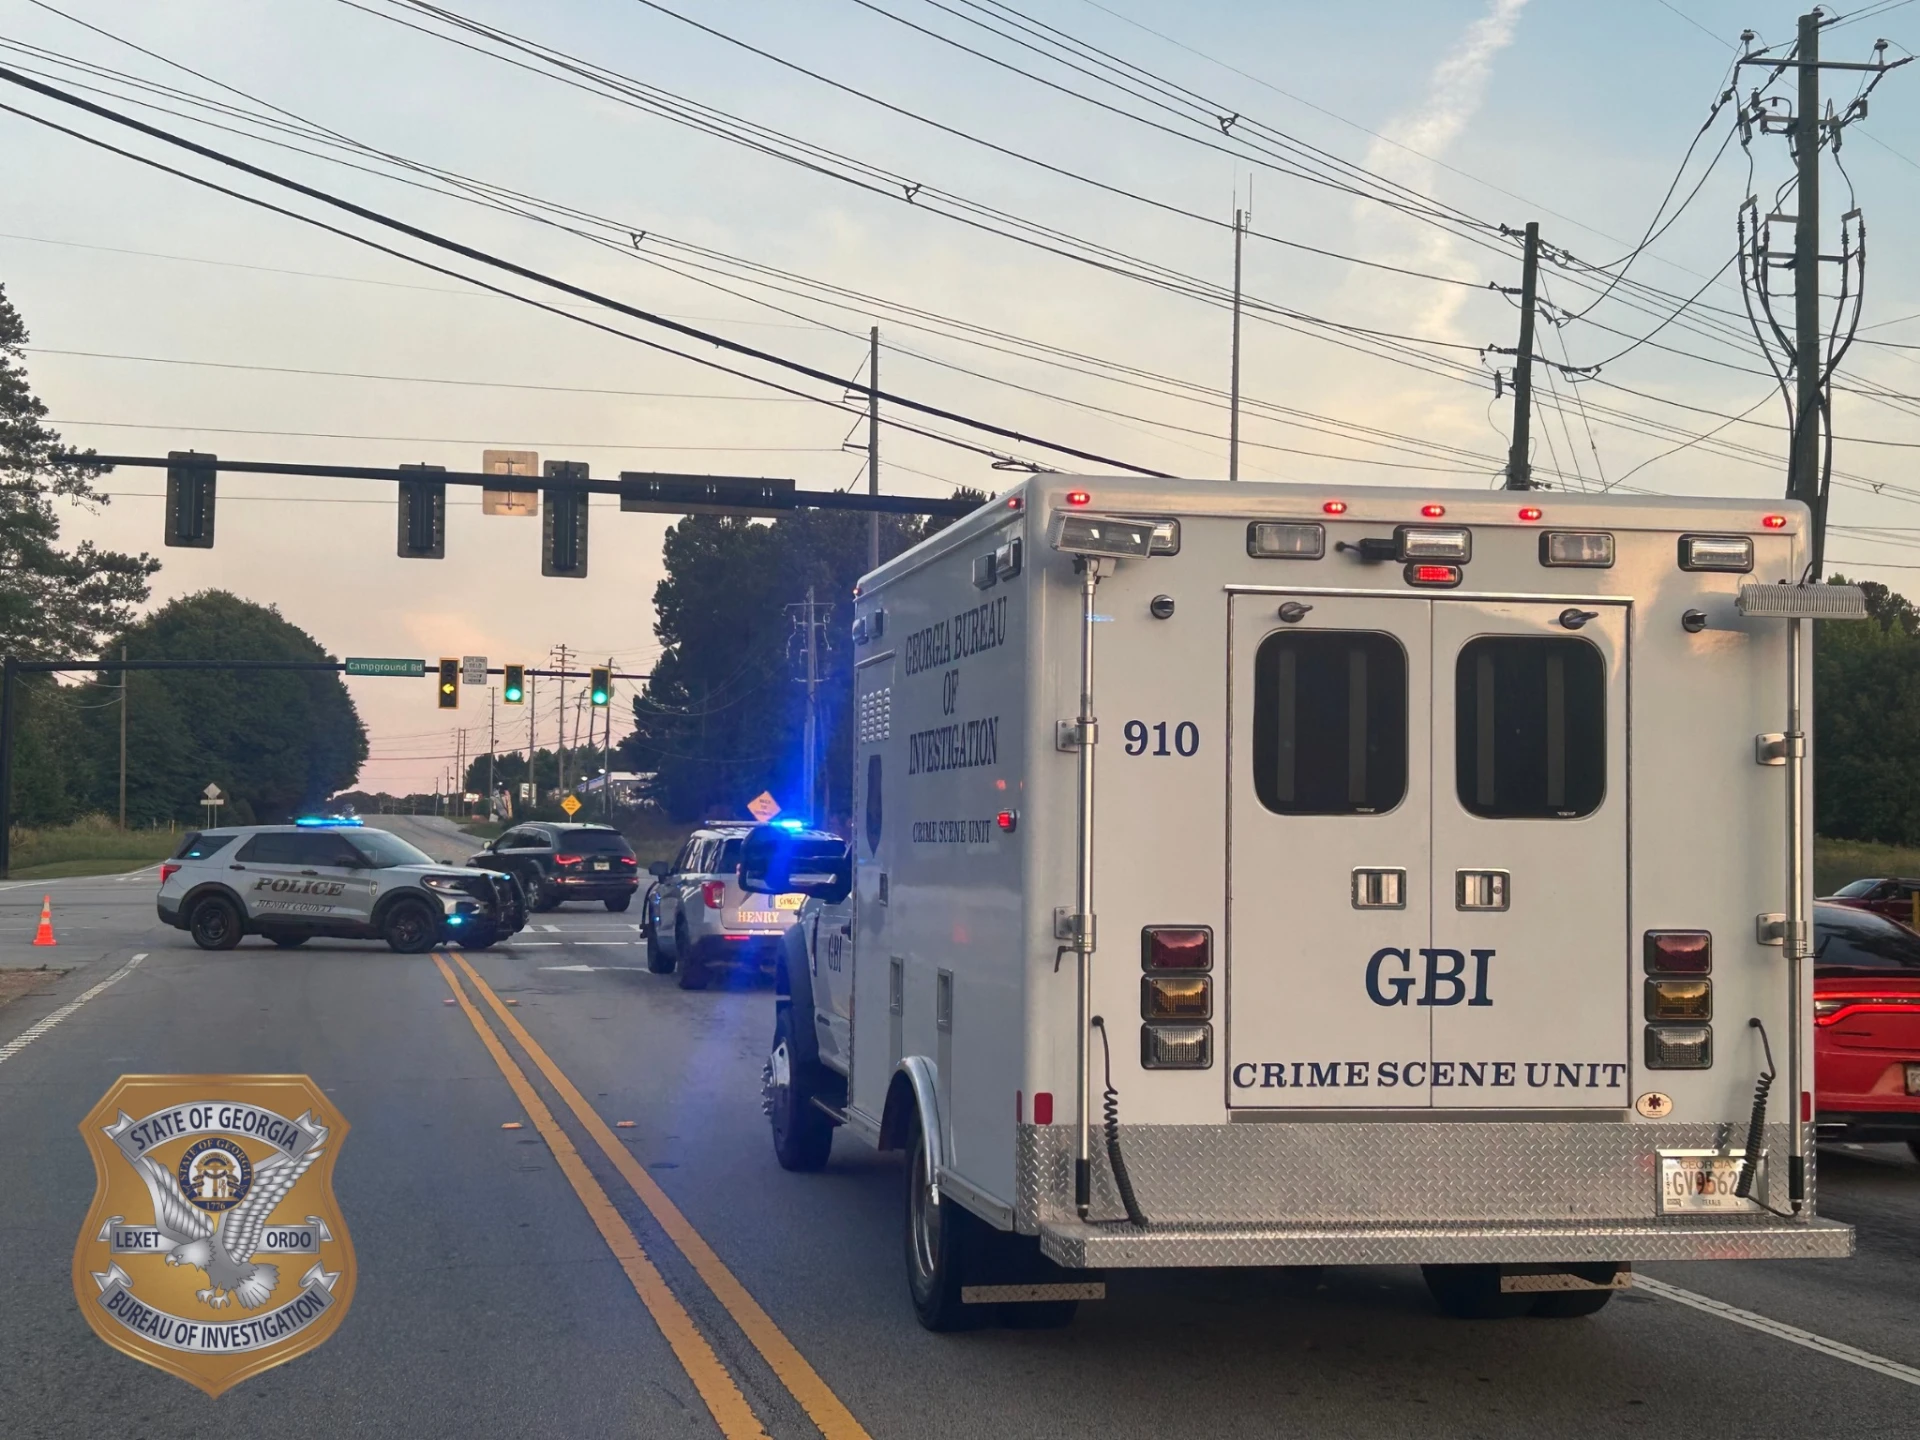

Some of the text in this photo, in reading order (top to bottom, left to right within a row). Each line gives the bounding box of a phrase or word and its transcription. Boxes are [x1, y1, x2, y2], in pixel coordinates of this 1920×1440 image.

[905, 596, 1008, 676] GEORGIA BUREAU
[348, 662, 423, 672] Campground Rd
[943, 668, 959, 716] OF
[908, 716, 999, 775] INVESTIGATION
[1123, 719, 1200, 757] 910
[912, 820, 992, 843] CRIME SCENE UNIT
[254, 877, 346, 897] POLICE
[256, 899, 336, 914] HENRY COUNTY
[737, 911, 780, 924] HENRY
[828, 933, 842, 973] GBI
[1364, 946, 1496, 1007] GBI
[1232, 1061, 1627, 1089] CRIME SCENE UNIT
[1680, 1160, 1733, 1170] GEORGIA
[1673, 1171, 1742, 1196] GV9562
